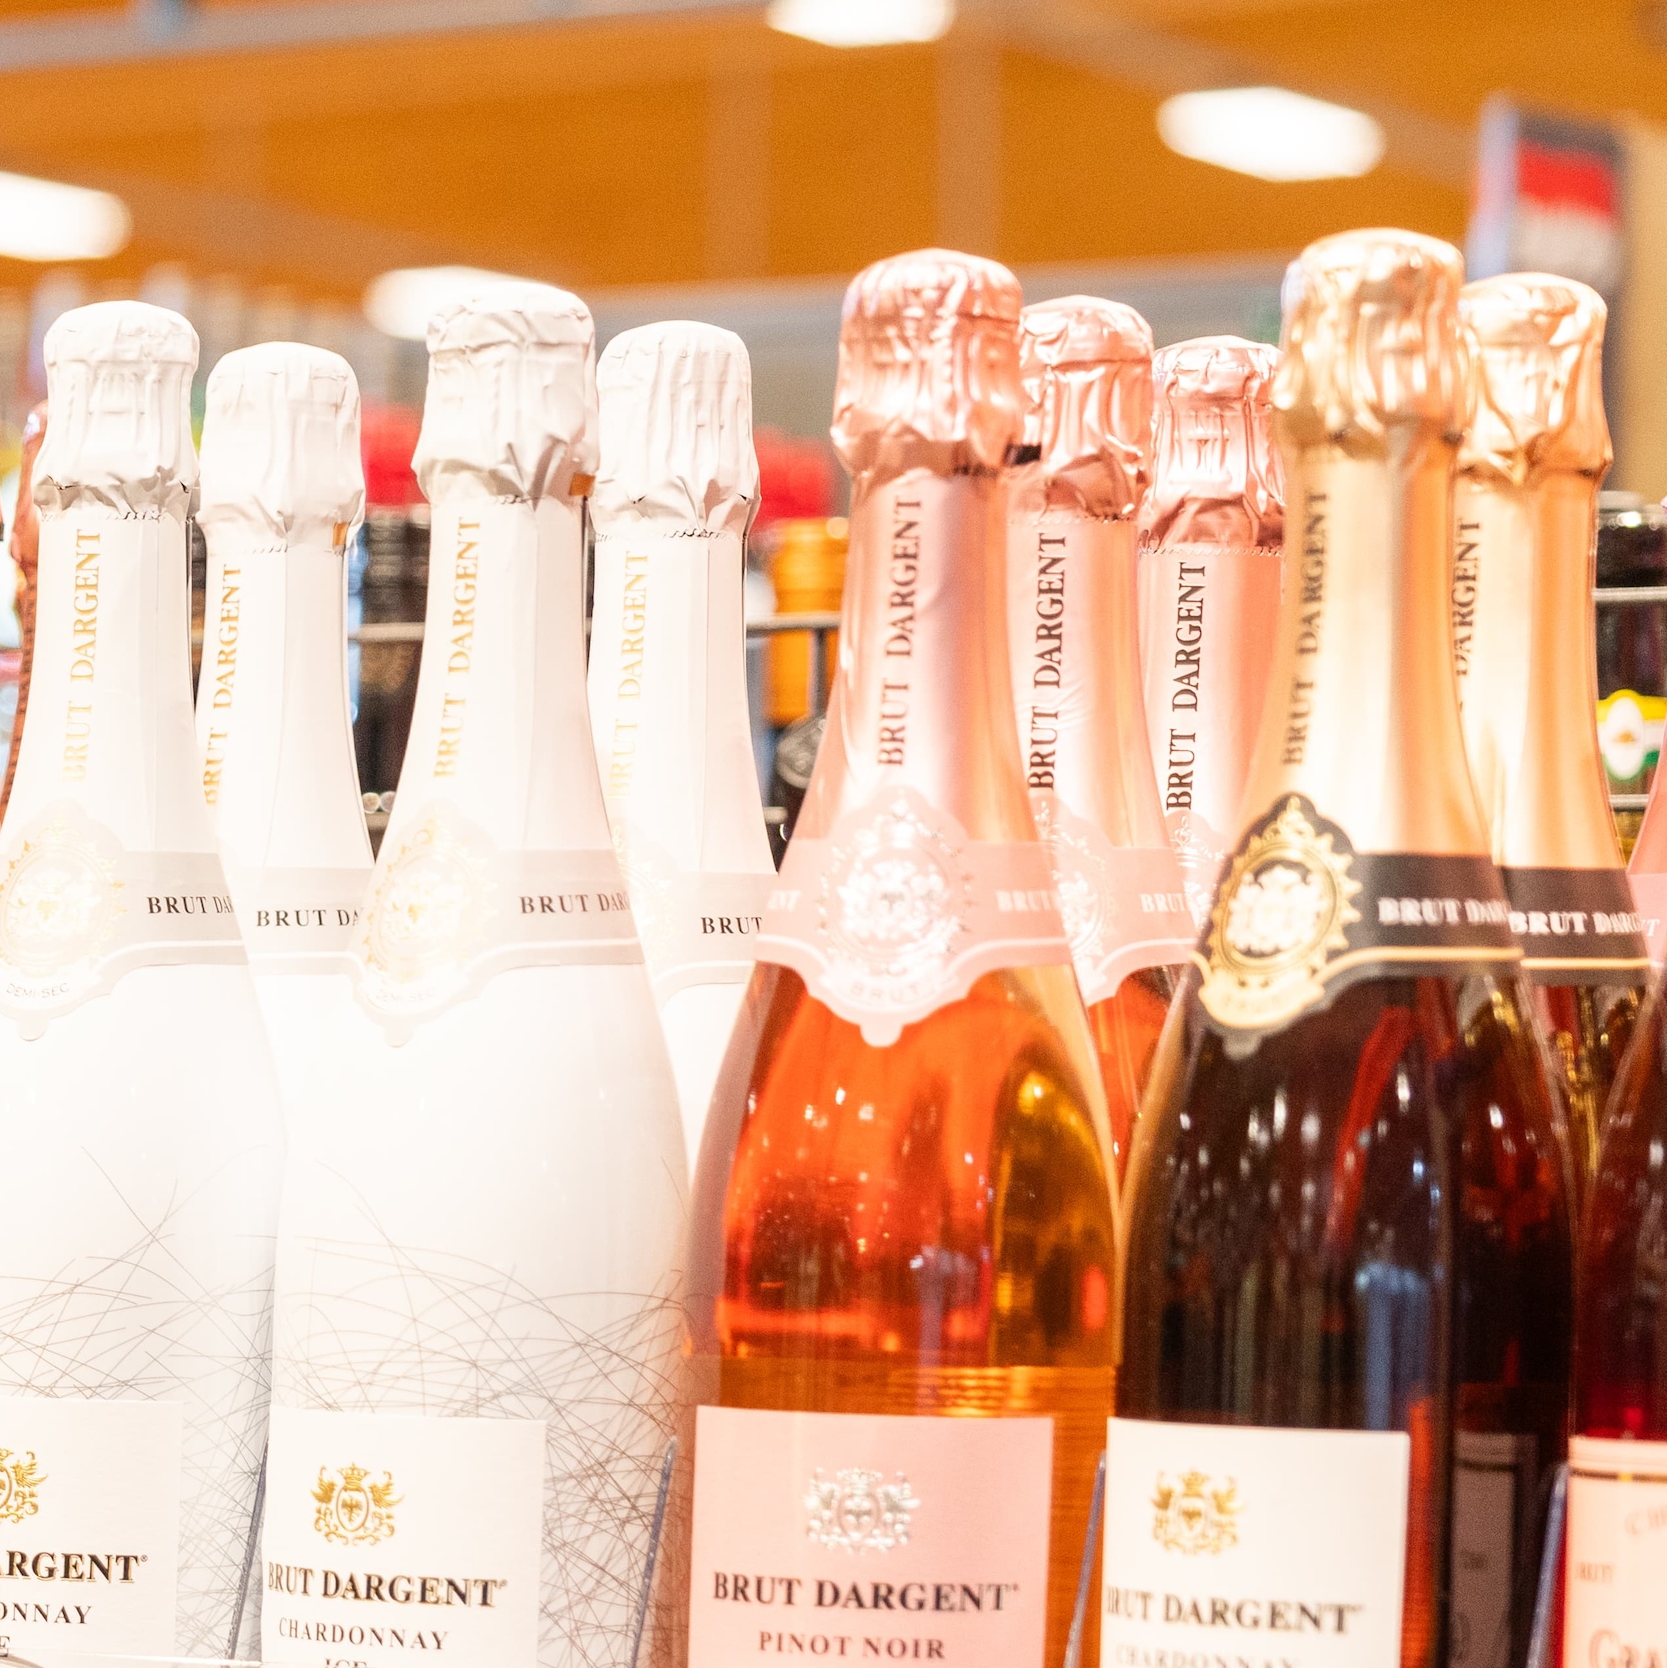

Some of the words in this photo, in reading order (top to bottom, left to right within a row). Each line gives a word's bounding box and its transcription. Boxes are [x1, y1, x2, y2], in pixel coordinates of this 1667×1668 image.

[70, 529, 102, 683] DARGENT
[448, 516, 480, 676] DARGENT
[886, 496, 922, 658] DARGENT
[1034, 532, 1067, 688] DARGENT
[213, 563, 241, 709] DARGENT
[617, 550, 649, 701] DARGENT
[1172, 562, 1205, 712] DARGENT
[1283, 677, 1314, 766] BRUT
[1300, 491, 1328, 656] DARGENT
[434, 693, 467, 780] BRUT
[878, 678, 908, 767] BRUT
[1027, 706, 1058, 791] BRUT
[1167, 729, 1196, 810] BRUT
[147, 896, 206, 915] BRUT
[255, 909, 327, 928] BRUT
[520, 895, 589, 915] BRUT
[1378, 898, 1458, 926] BRUT
[1511, 911, 1587, 936] BRUT
[267, 1561, 315, 1596] BRUT
[322, 1570, 498, 1608] DARGENT
[712, 1572, 801, 1608] BRUT
[814, 1578, 1011, 1614] DARGENT
[1164, 1592, 1348, 1634] DARGENT
[278, 1617, 449, 1651] CHARDONNAY
[758, 1630, 852, 1660] PINOT
[862, 1634, 946, 1662] NOIR
